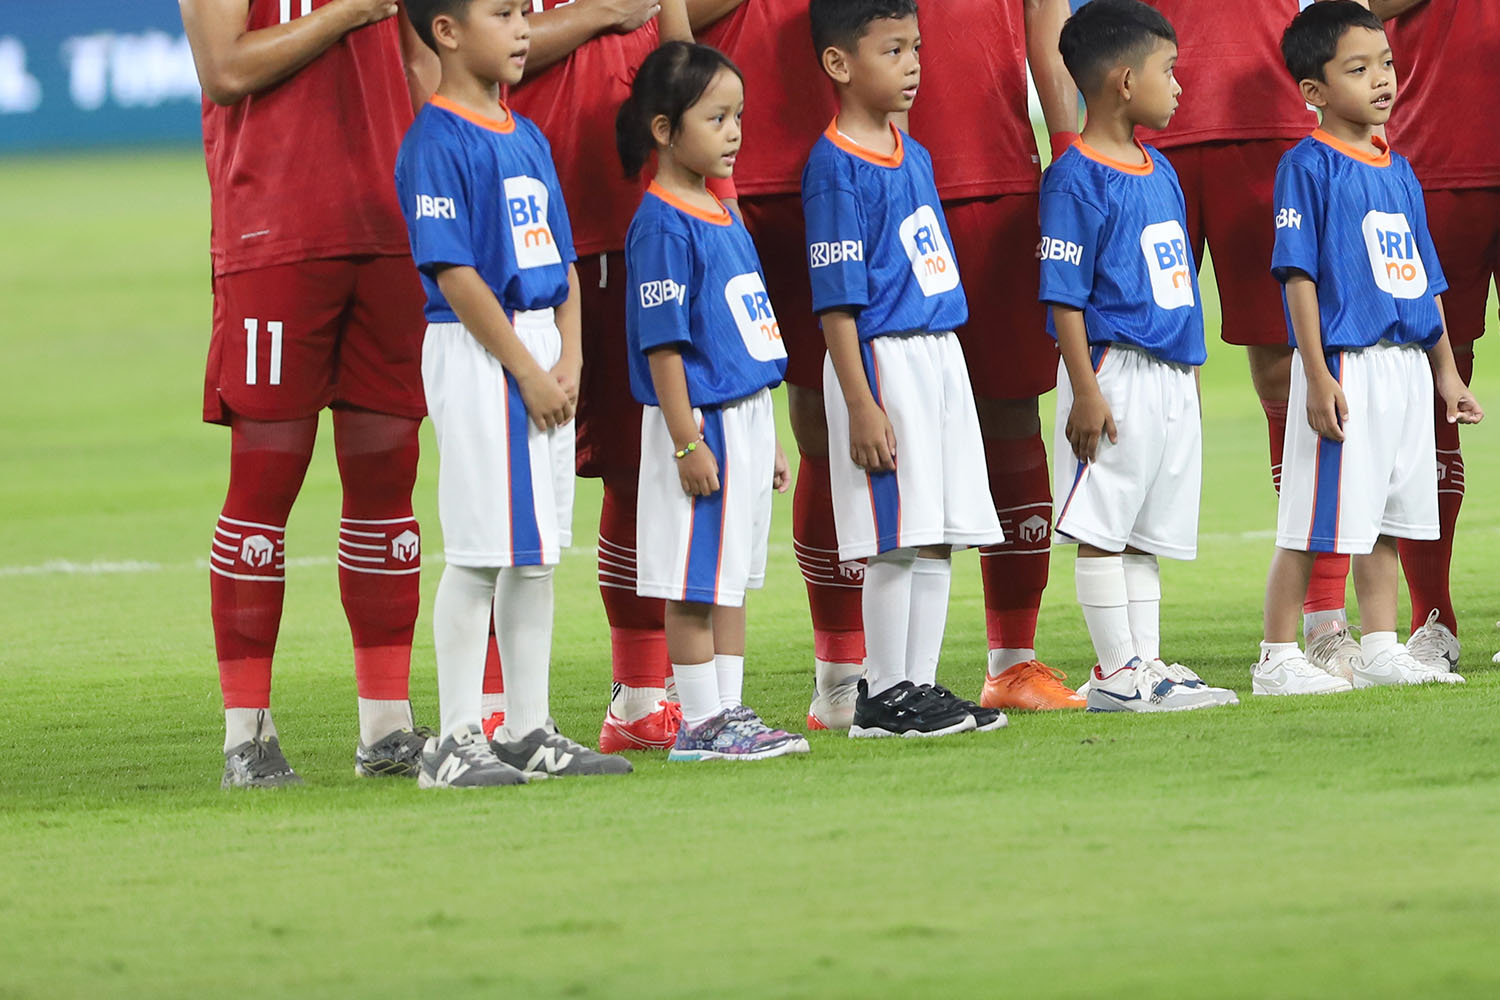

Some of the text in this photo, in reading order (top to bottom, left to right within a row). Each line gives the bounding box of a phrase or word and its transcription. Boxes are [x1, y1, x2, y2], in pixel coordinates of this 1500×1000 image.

[421, 194, 456, 219] BRI
[830, 240, 864, 264] BRI
[1050, 238, 1084, 267] BRI
[244, 318, 283, 386] 11
